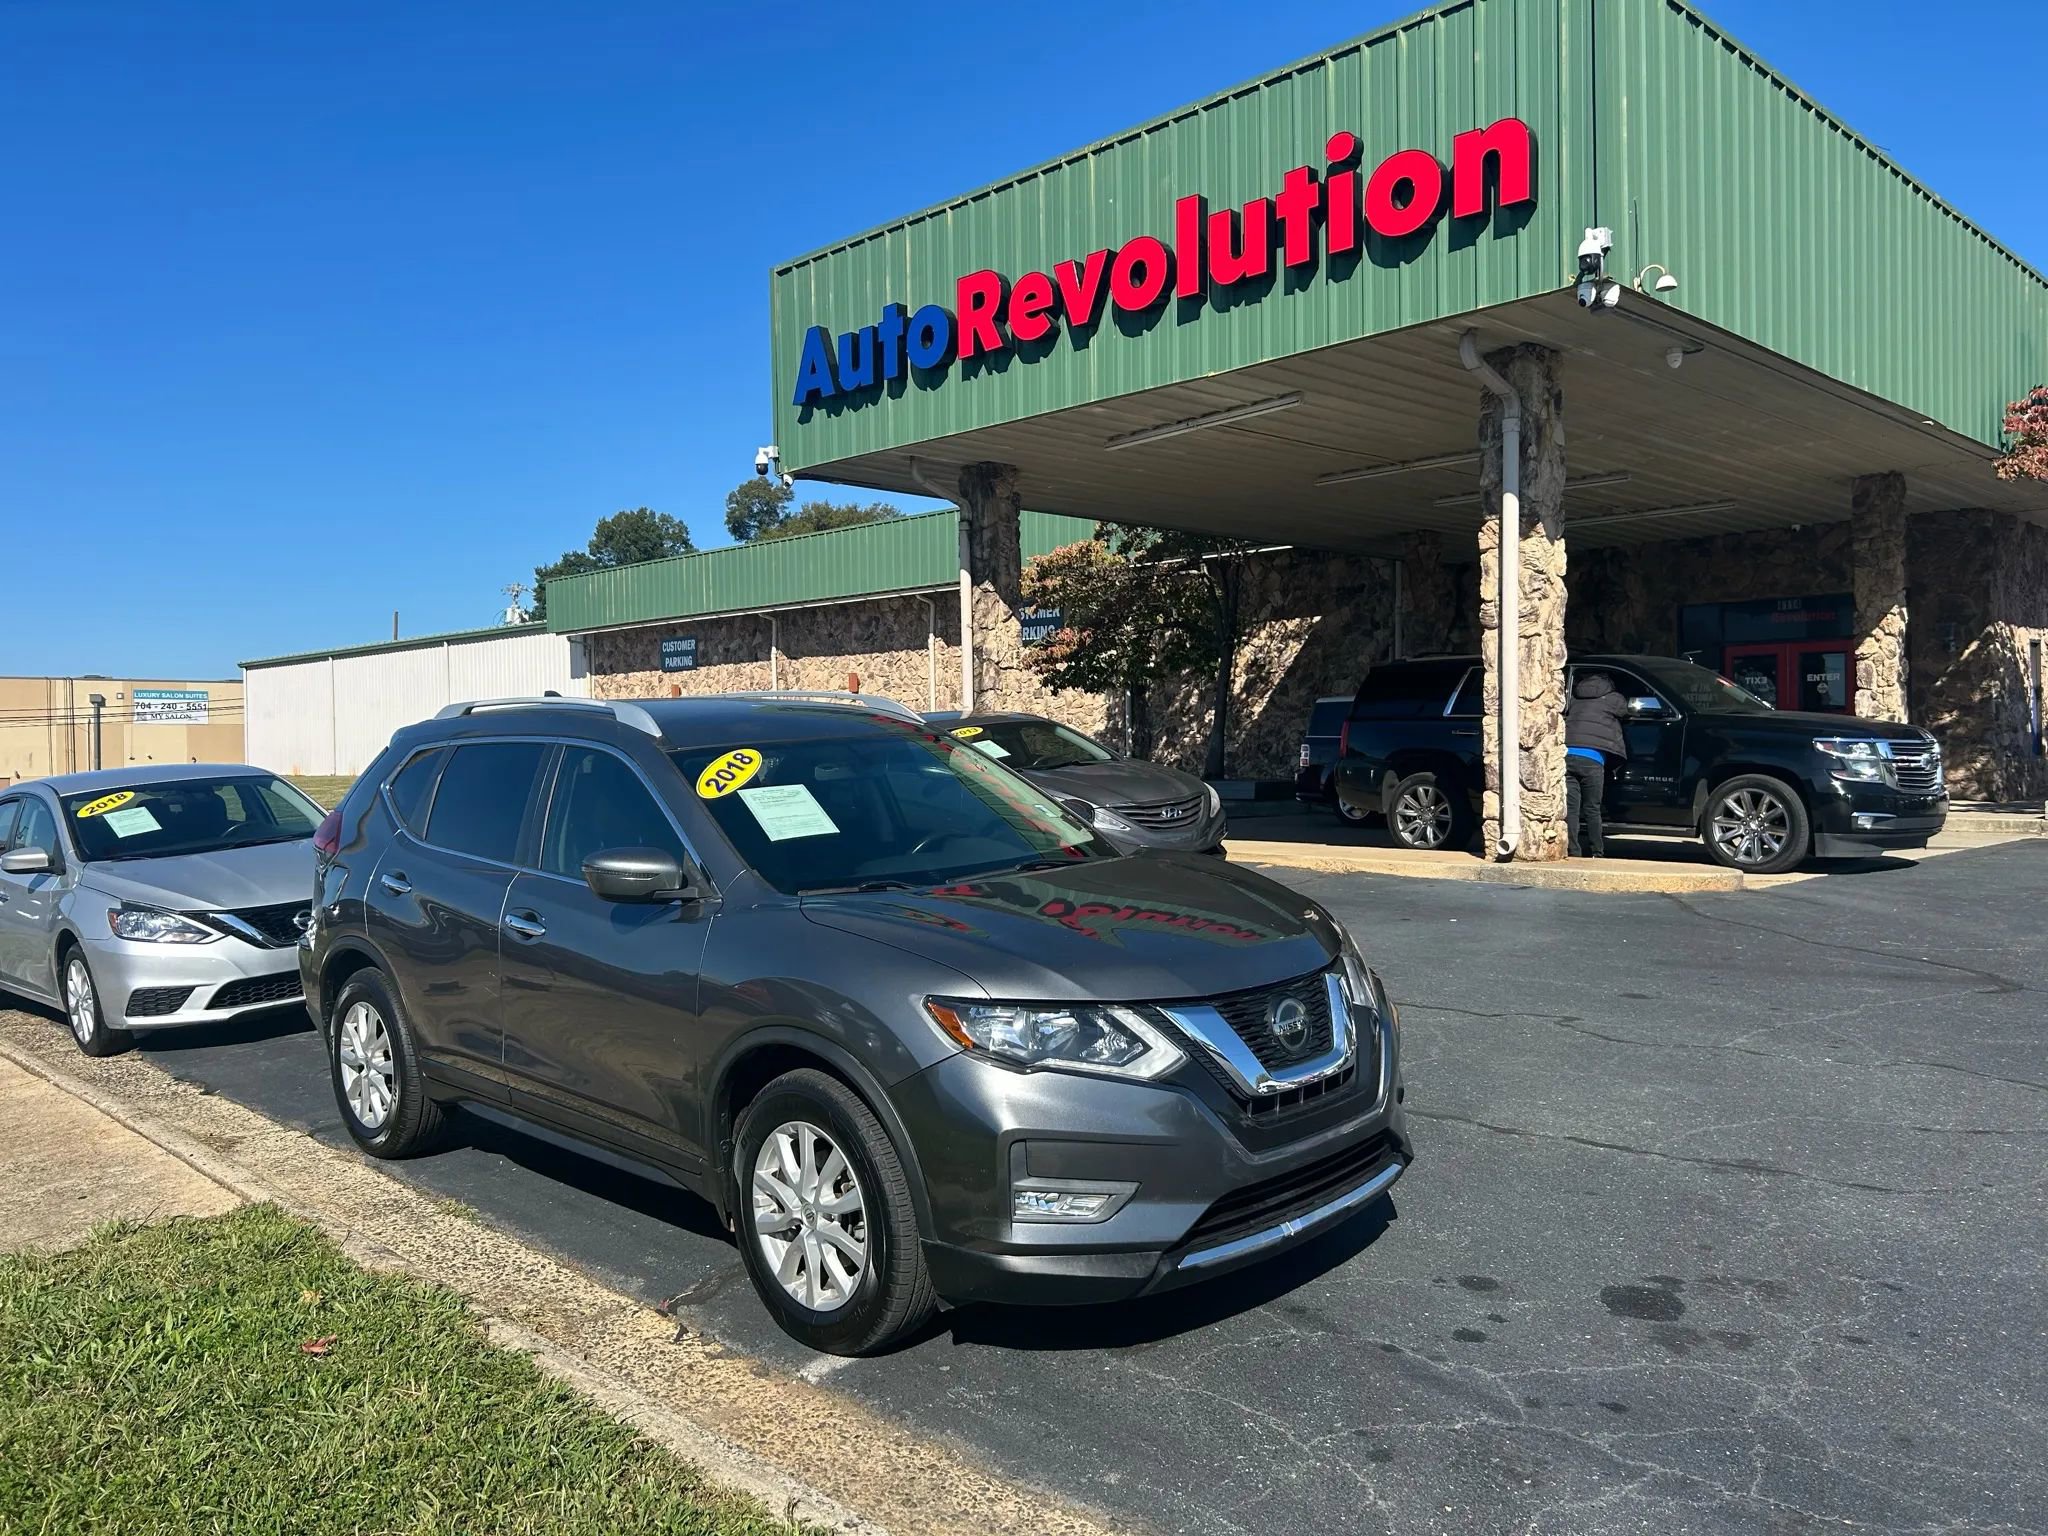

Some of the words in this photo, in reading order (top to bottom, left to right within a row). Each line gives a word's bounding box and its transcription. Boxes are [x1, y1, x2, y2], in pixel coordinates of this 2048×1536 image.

[1019, 607, 1060, 620] STOMER
[1022, 625, 1055, 640] RKING
[662, 639, 696, 652] CUSTOMER
[665, 655, 693, 668] PARKING
[1806, 672, 1841, 682] ENTER
[135, 702, 151, 710] 704
[160, 702, 177, 710] 240
[186, 703, 207, 711] 5551
[705, 752, 754, 793] 2018
[85, 793, 128, 815] 2018
